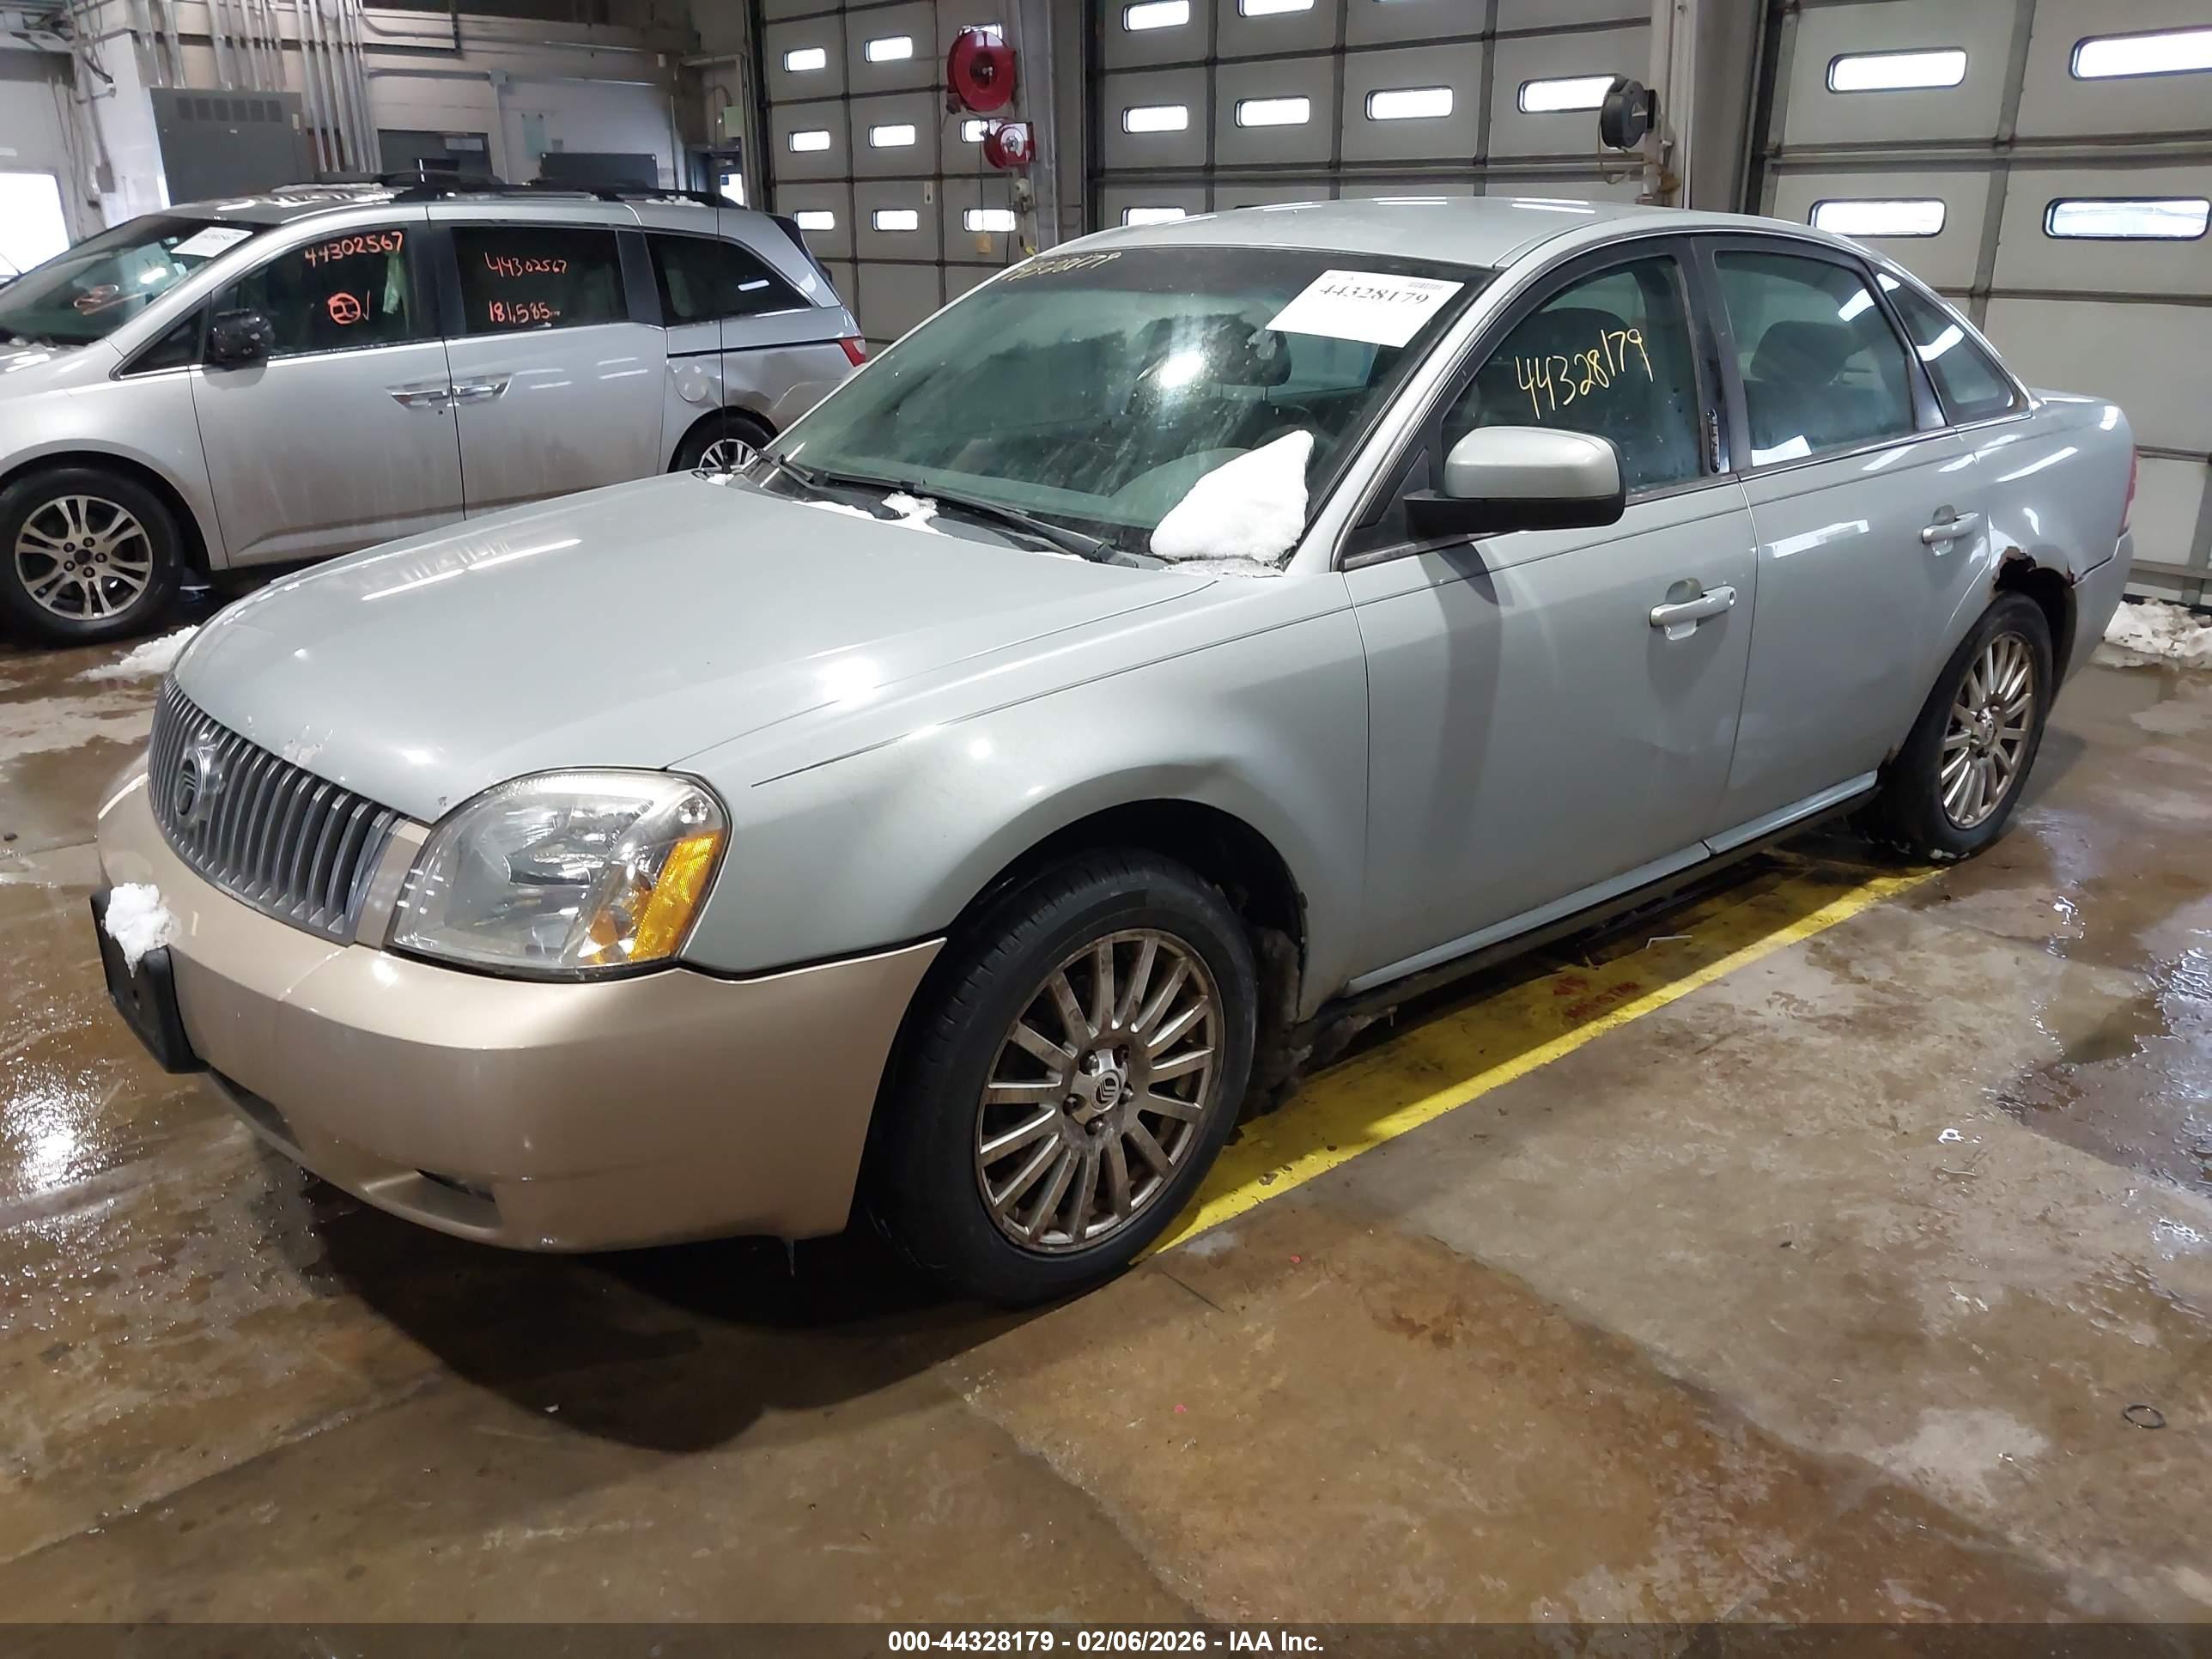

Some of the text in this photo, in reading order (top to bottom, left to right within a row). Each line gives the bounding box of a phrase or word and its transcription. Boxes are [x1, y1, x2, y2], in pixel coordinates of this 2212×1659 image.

[304, 230, 404, 268] 44302567
[483, 251, 568, 277] 44302567
[1319, 284, 1430, 304] 44328179
[1515, 328, 1654, 420] 44328179
